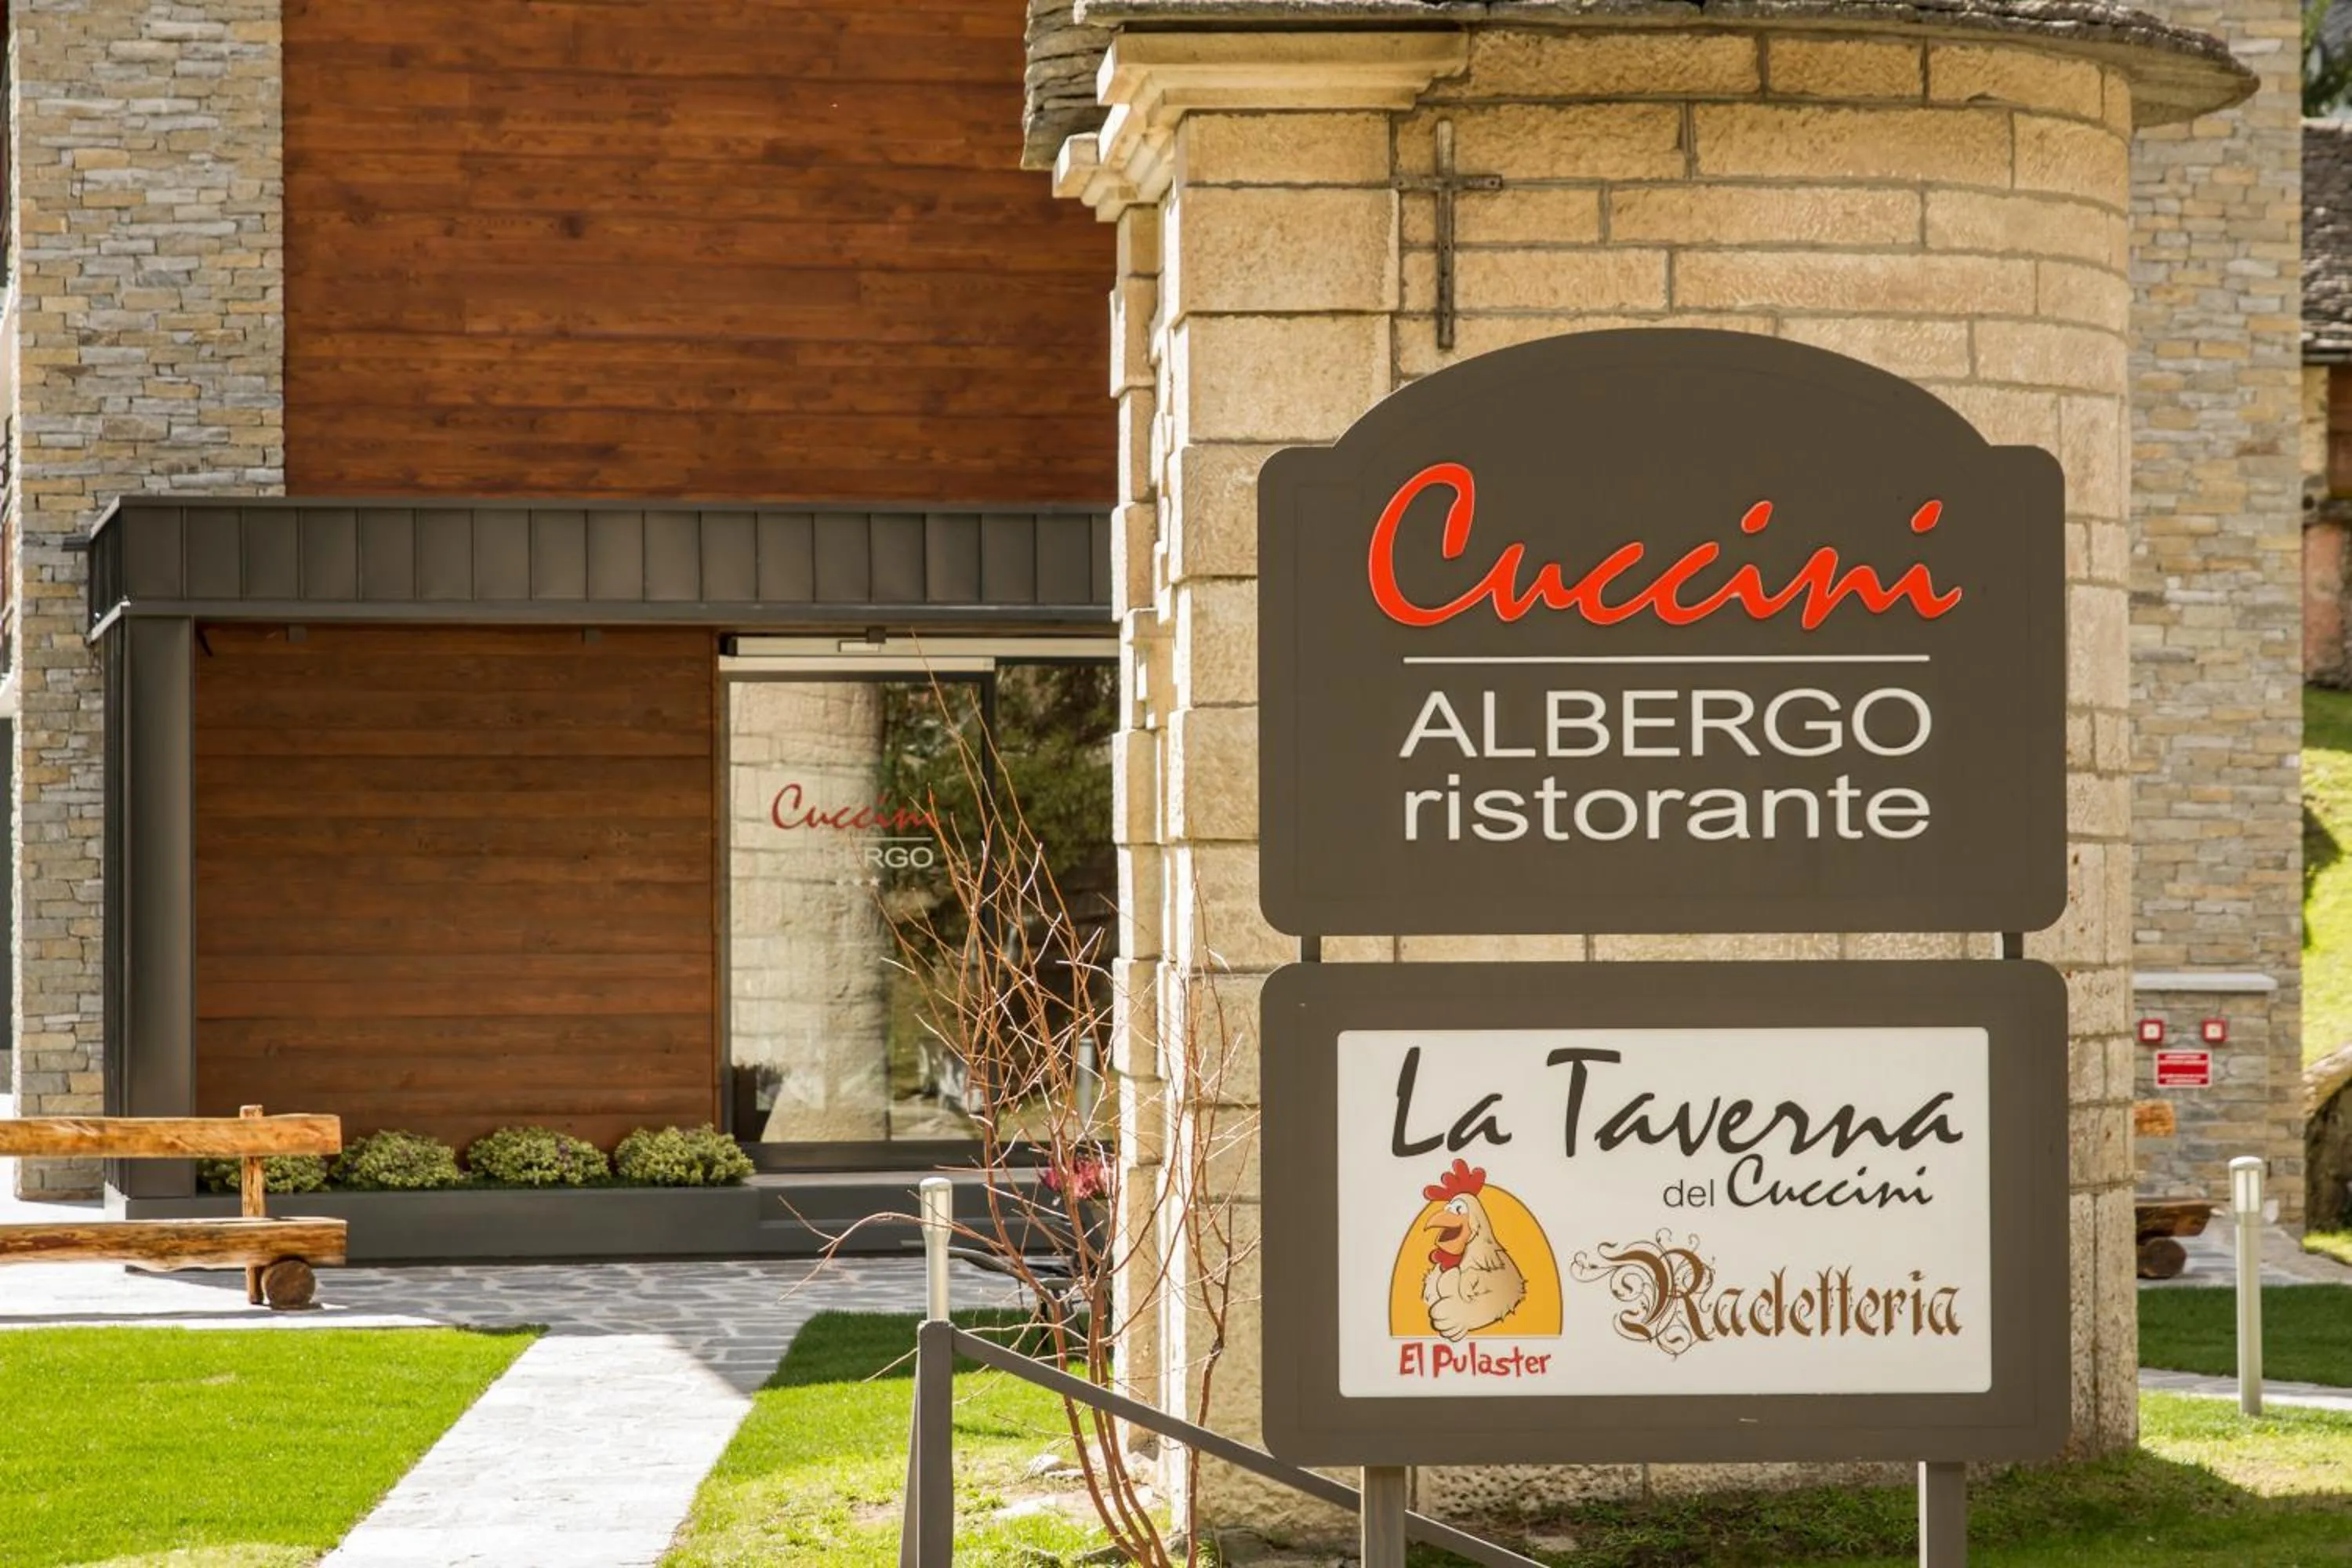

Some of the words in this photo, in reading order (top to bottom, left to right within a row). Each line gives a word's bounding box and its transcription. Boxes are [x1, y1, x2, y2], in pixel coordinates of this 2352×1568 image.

[1368, 462, 1962, 630] Cuccini
[1399, 688, 1932, 758] ALBERGO
[1405, 774, 1930, 841] ristorante
[1392, 1046, 1512, 1158] La
[1546, 1047, 1964, 1158] Taverna
[1663, 1178, 1715, 1208] del
[1726, 1154, 1933, 1209] Cuccini
[1399, 1341, 1424, 1377] El
[1432, 1341, 1552, 1378] Pulaster
